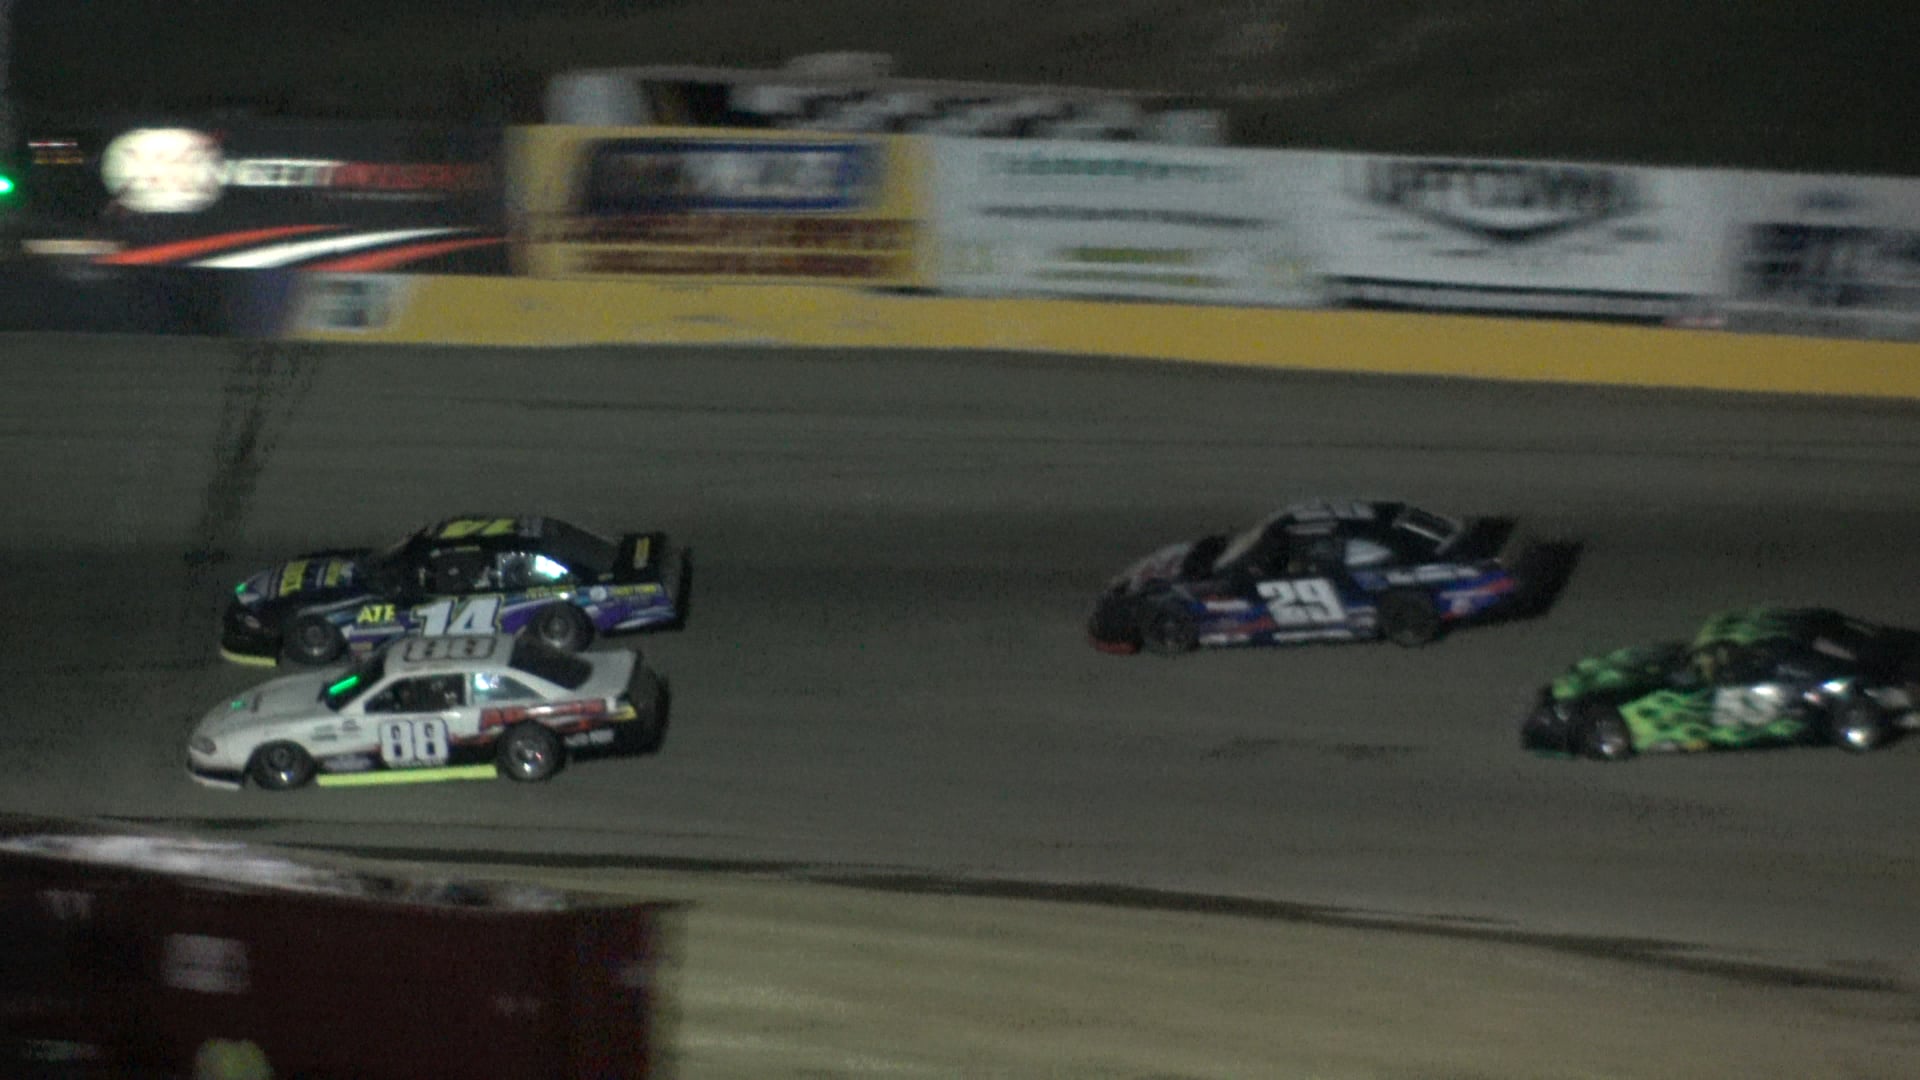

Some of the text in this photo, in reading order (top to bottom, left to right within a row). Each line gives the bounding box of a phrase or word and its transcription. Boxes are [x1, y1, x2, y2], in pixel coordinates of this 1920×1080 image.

[411, 594, 503, 638] 14
[1256, 578, 1344, 626] 29
[380, 718, 449, 764] 88
